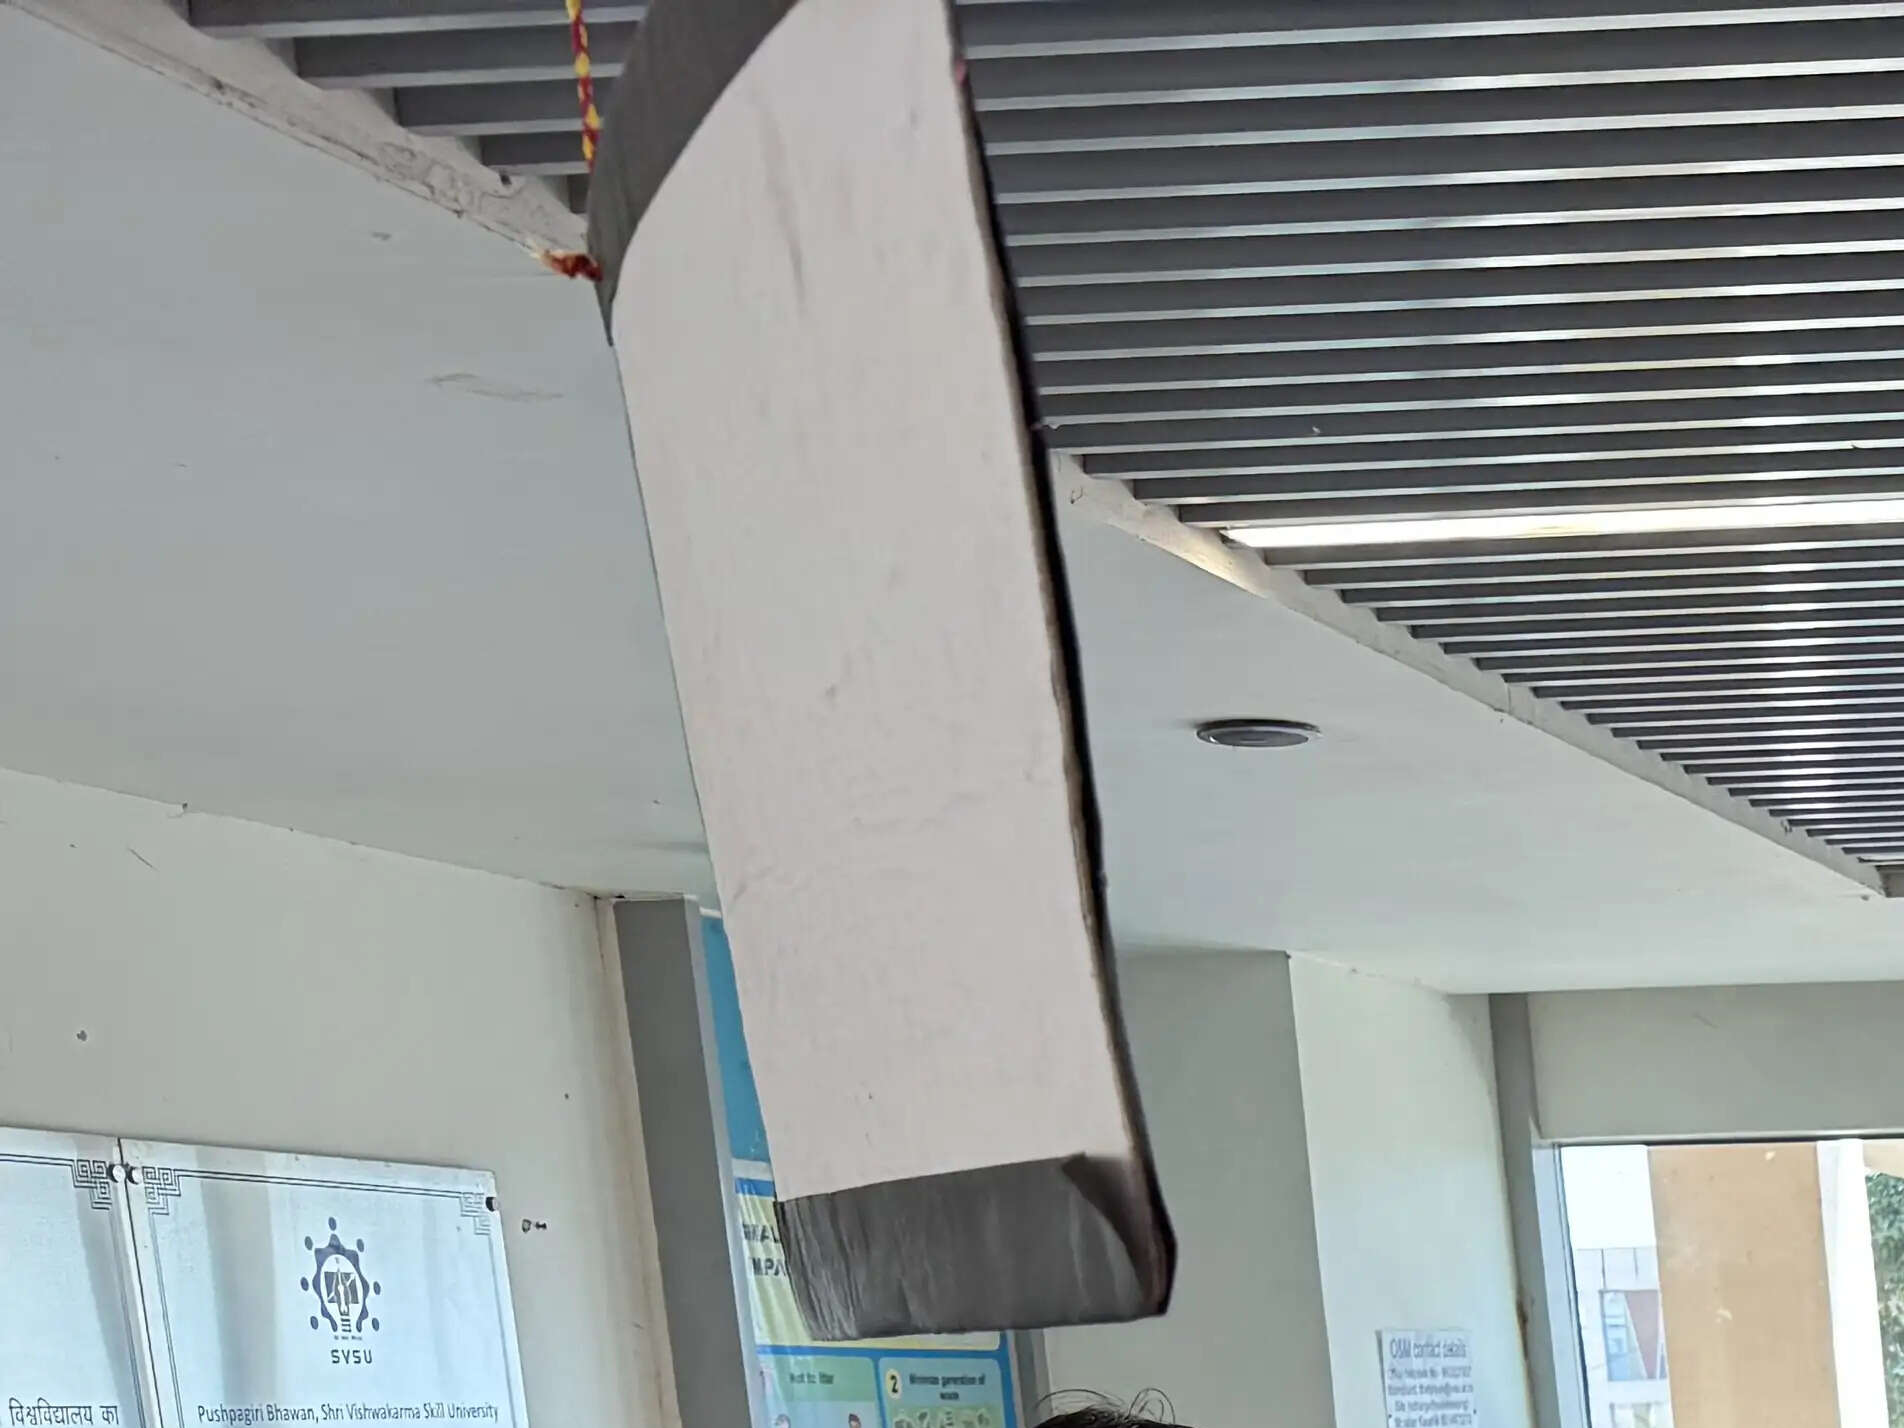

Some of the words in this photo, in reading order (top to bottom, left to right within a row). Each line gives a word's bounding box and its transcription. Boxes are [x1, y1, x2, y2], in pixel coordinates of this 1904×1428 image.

[331, 1349, 373, 1364] SVSU
[890, 1375, 899, 1393] 2
[8, 1397, 93, 1426] विश्वविद्यालय
[100, 1405, 119, 1425] का
[198, 1404, 264, 1426] Pushpagiri
[267, 1404, 319, 1424] Bhawan,
[321, 1404, 344, 1421] Shri
[347, 1404, 421, 1421] Vishwakarma
[424, 1403, 445, 1419] Skill
[449, 1402, 498, 1423] University
